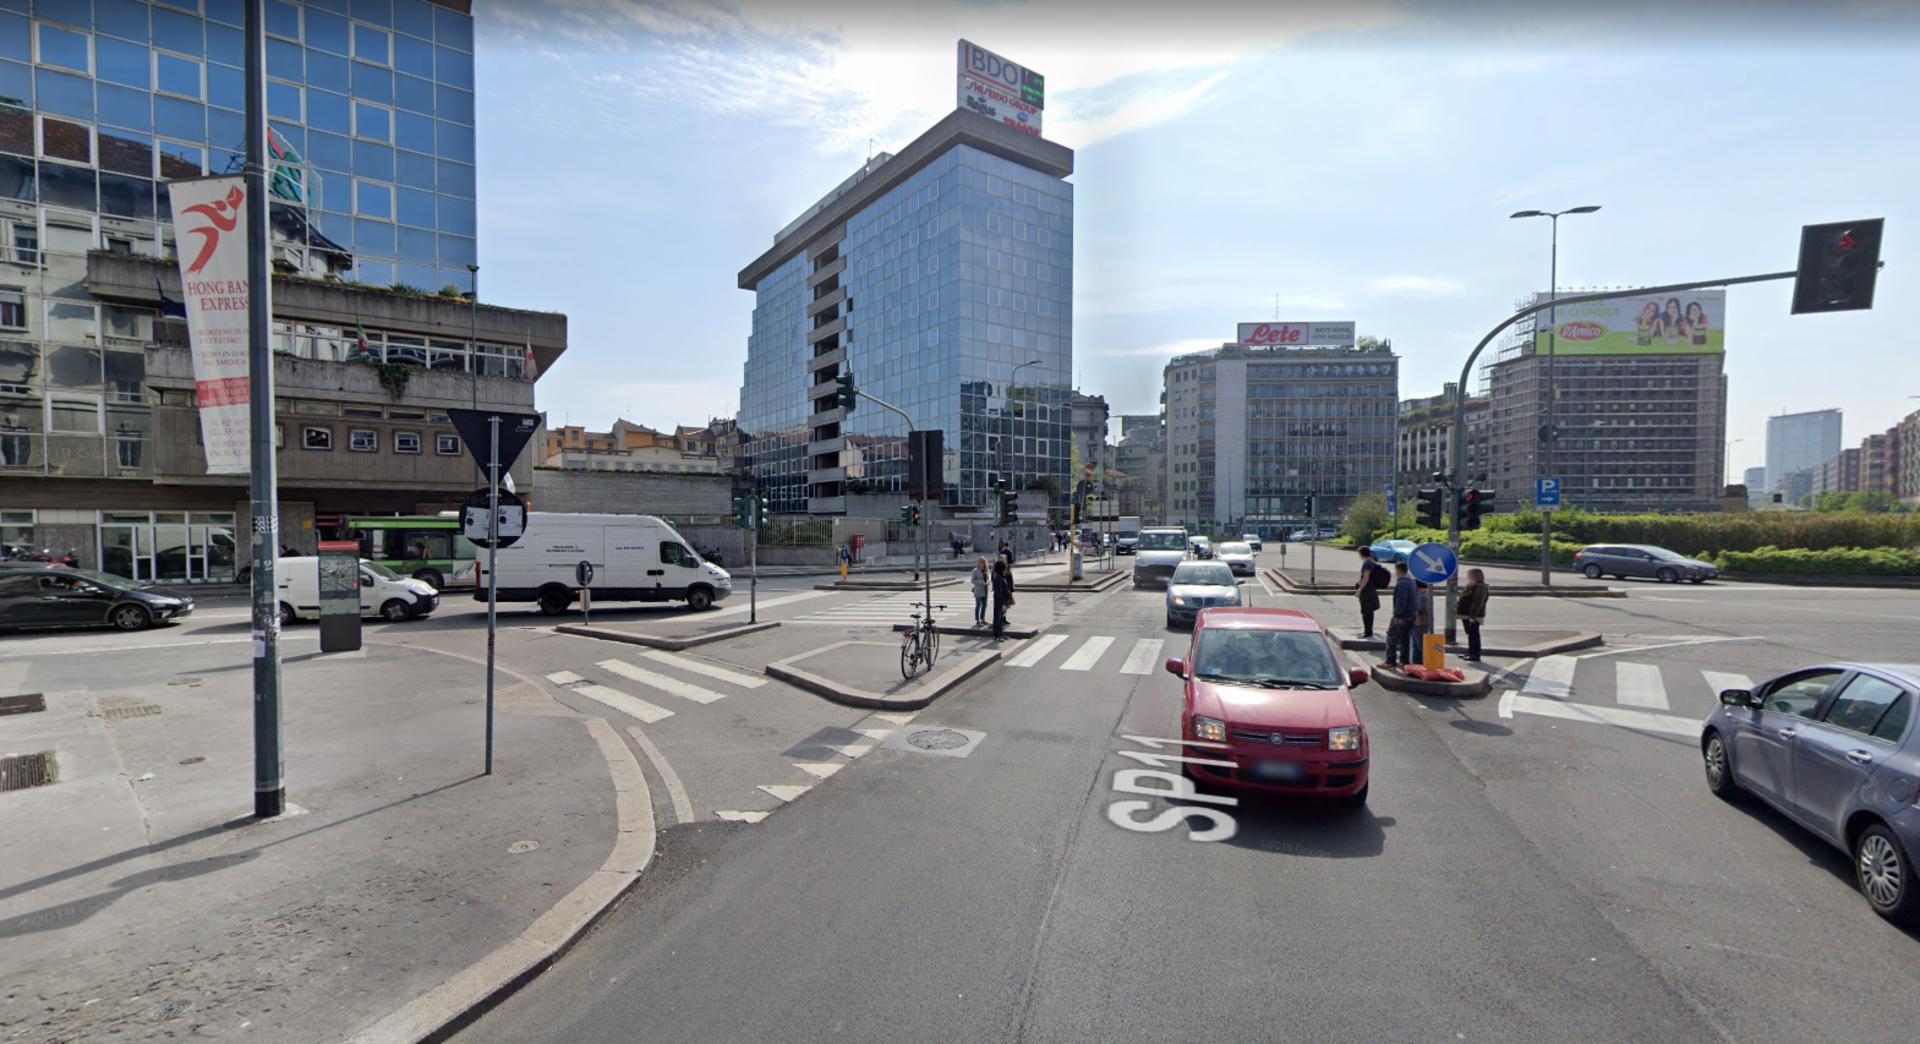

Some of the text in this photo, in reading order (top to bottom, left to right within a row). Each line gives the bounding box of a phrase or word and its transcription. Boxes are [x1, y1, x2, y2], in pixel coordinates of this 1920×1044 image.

[972, 47, 1018, 85] BDO
[1009, 98, 1038, 116] GROUP
[187, 281, 224, 296] HONG
[1243, 323, 1301, 346] Lete
[1541, 479, 1556, 493] P
